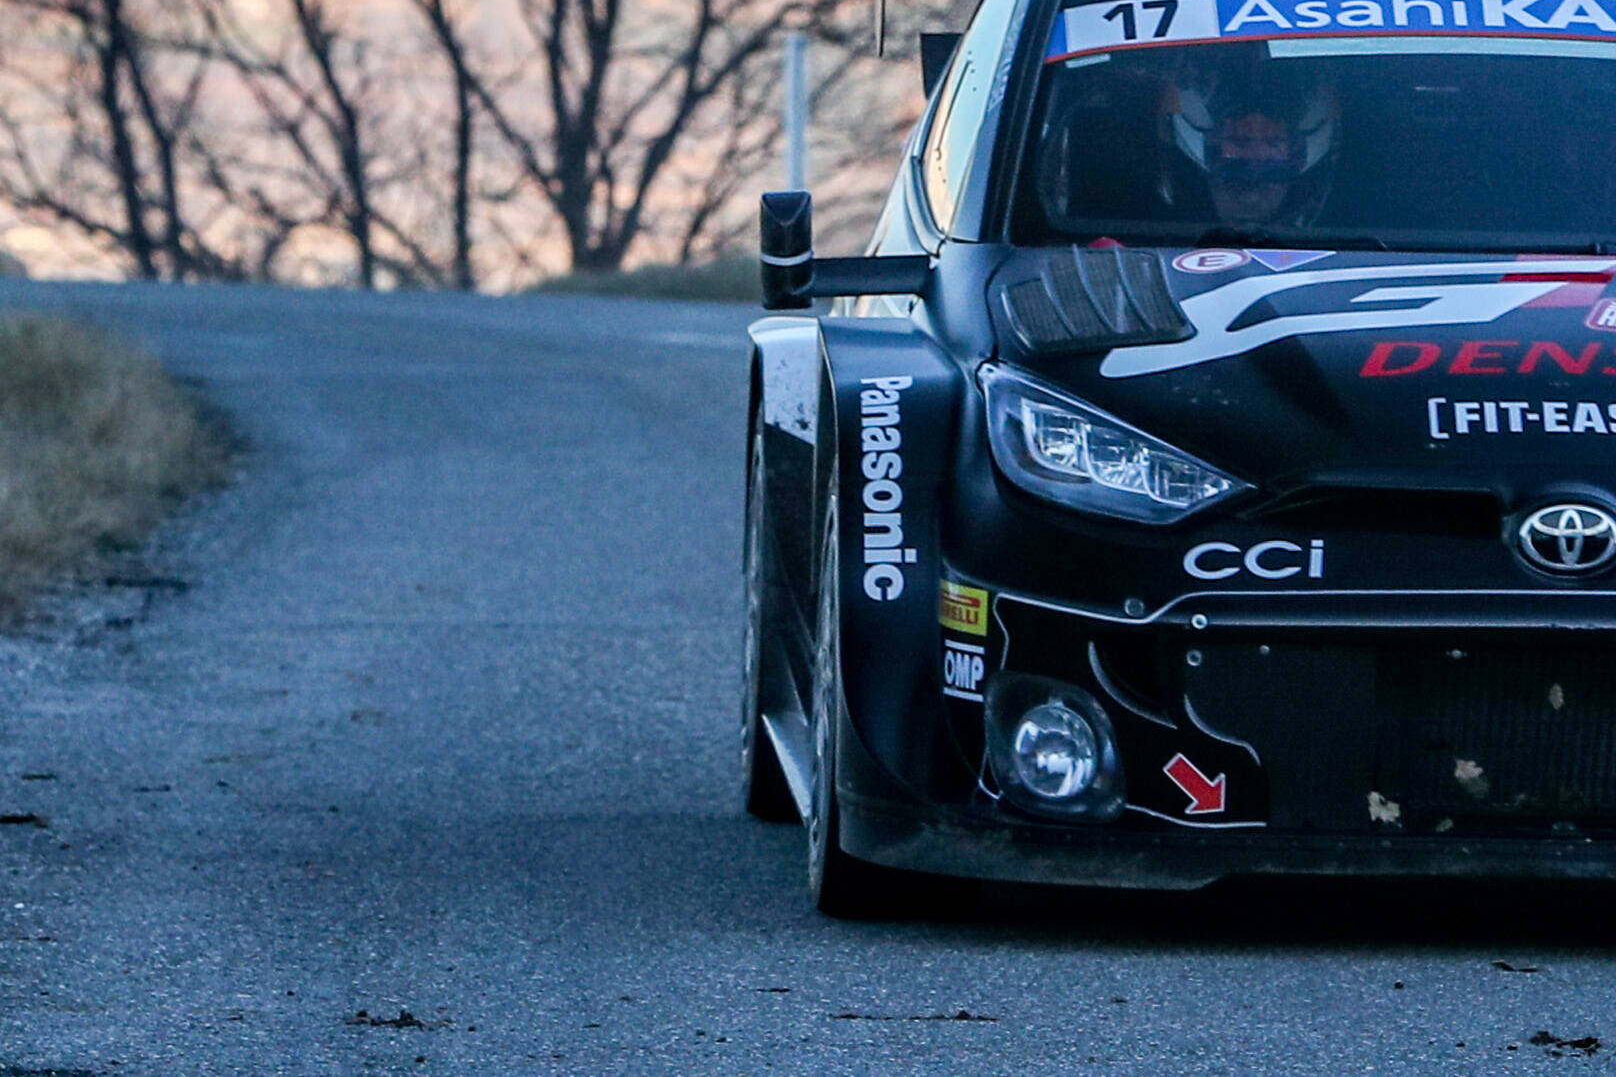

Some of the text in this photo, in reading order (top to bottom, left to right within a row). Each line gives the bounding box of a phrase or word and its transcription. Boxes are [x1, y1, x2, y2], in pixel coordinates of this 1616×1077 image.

[1102, 0, 1178, 40] 17
[860, 375, 917, 601] Panasonic
[944, 649, 985, 691] OMP
